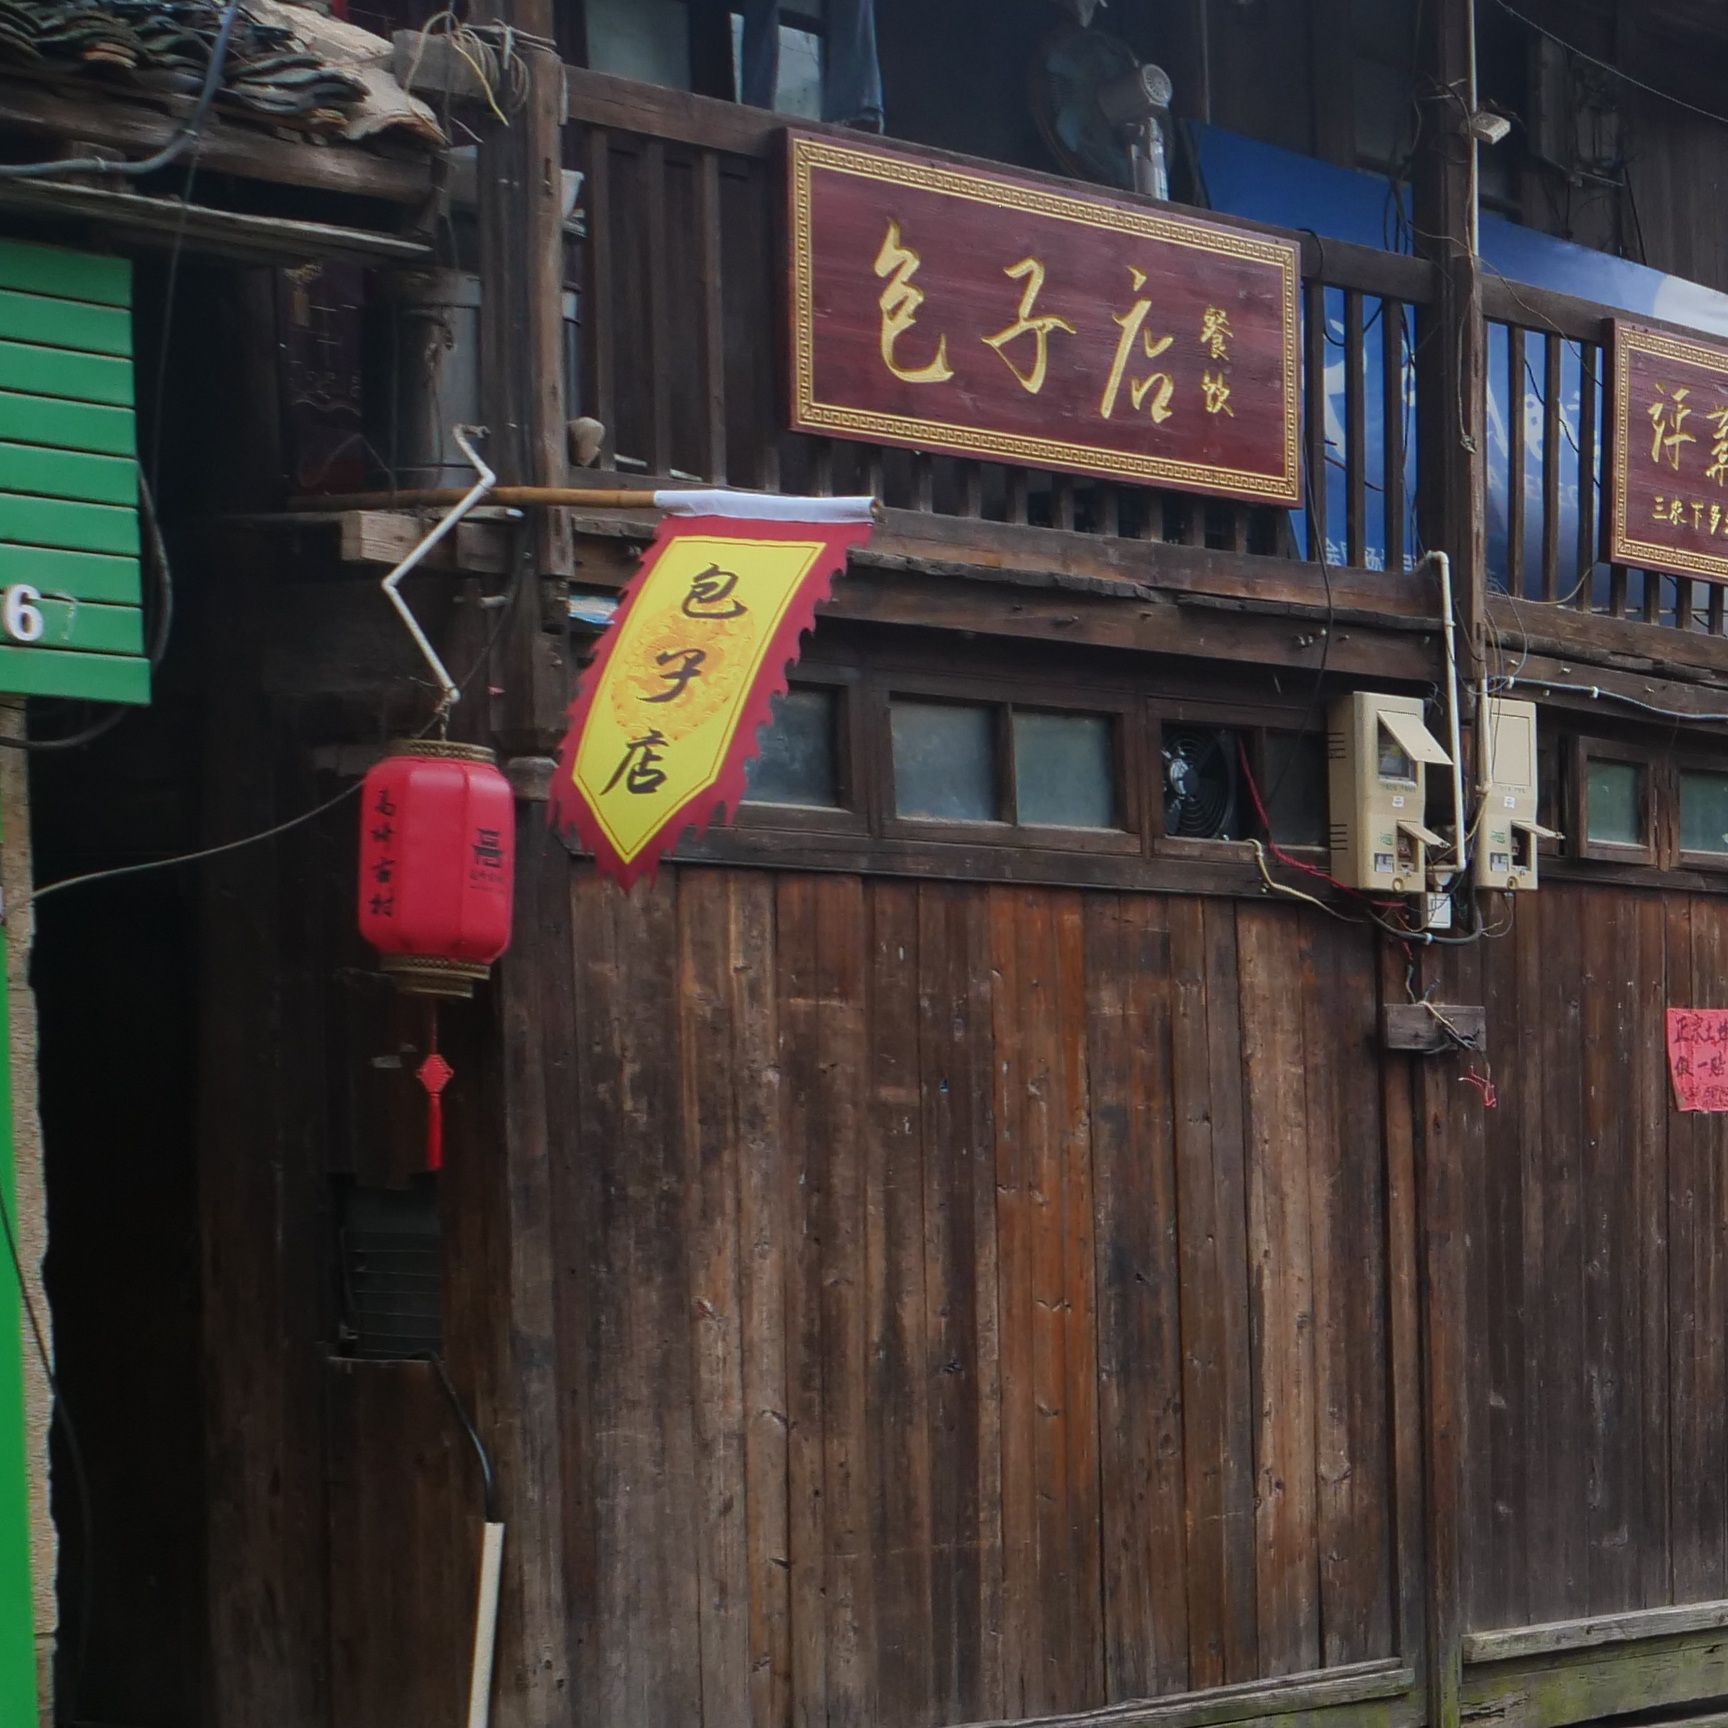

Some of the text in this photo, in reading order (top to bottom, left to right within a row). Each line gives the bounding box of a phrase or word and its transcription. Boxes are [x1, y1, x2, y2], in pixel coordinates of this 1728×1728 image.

[874, 215, 1174, 424] 包子店
[600, 562, 748, 796] 包子店
